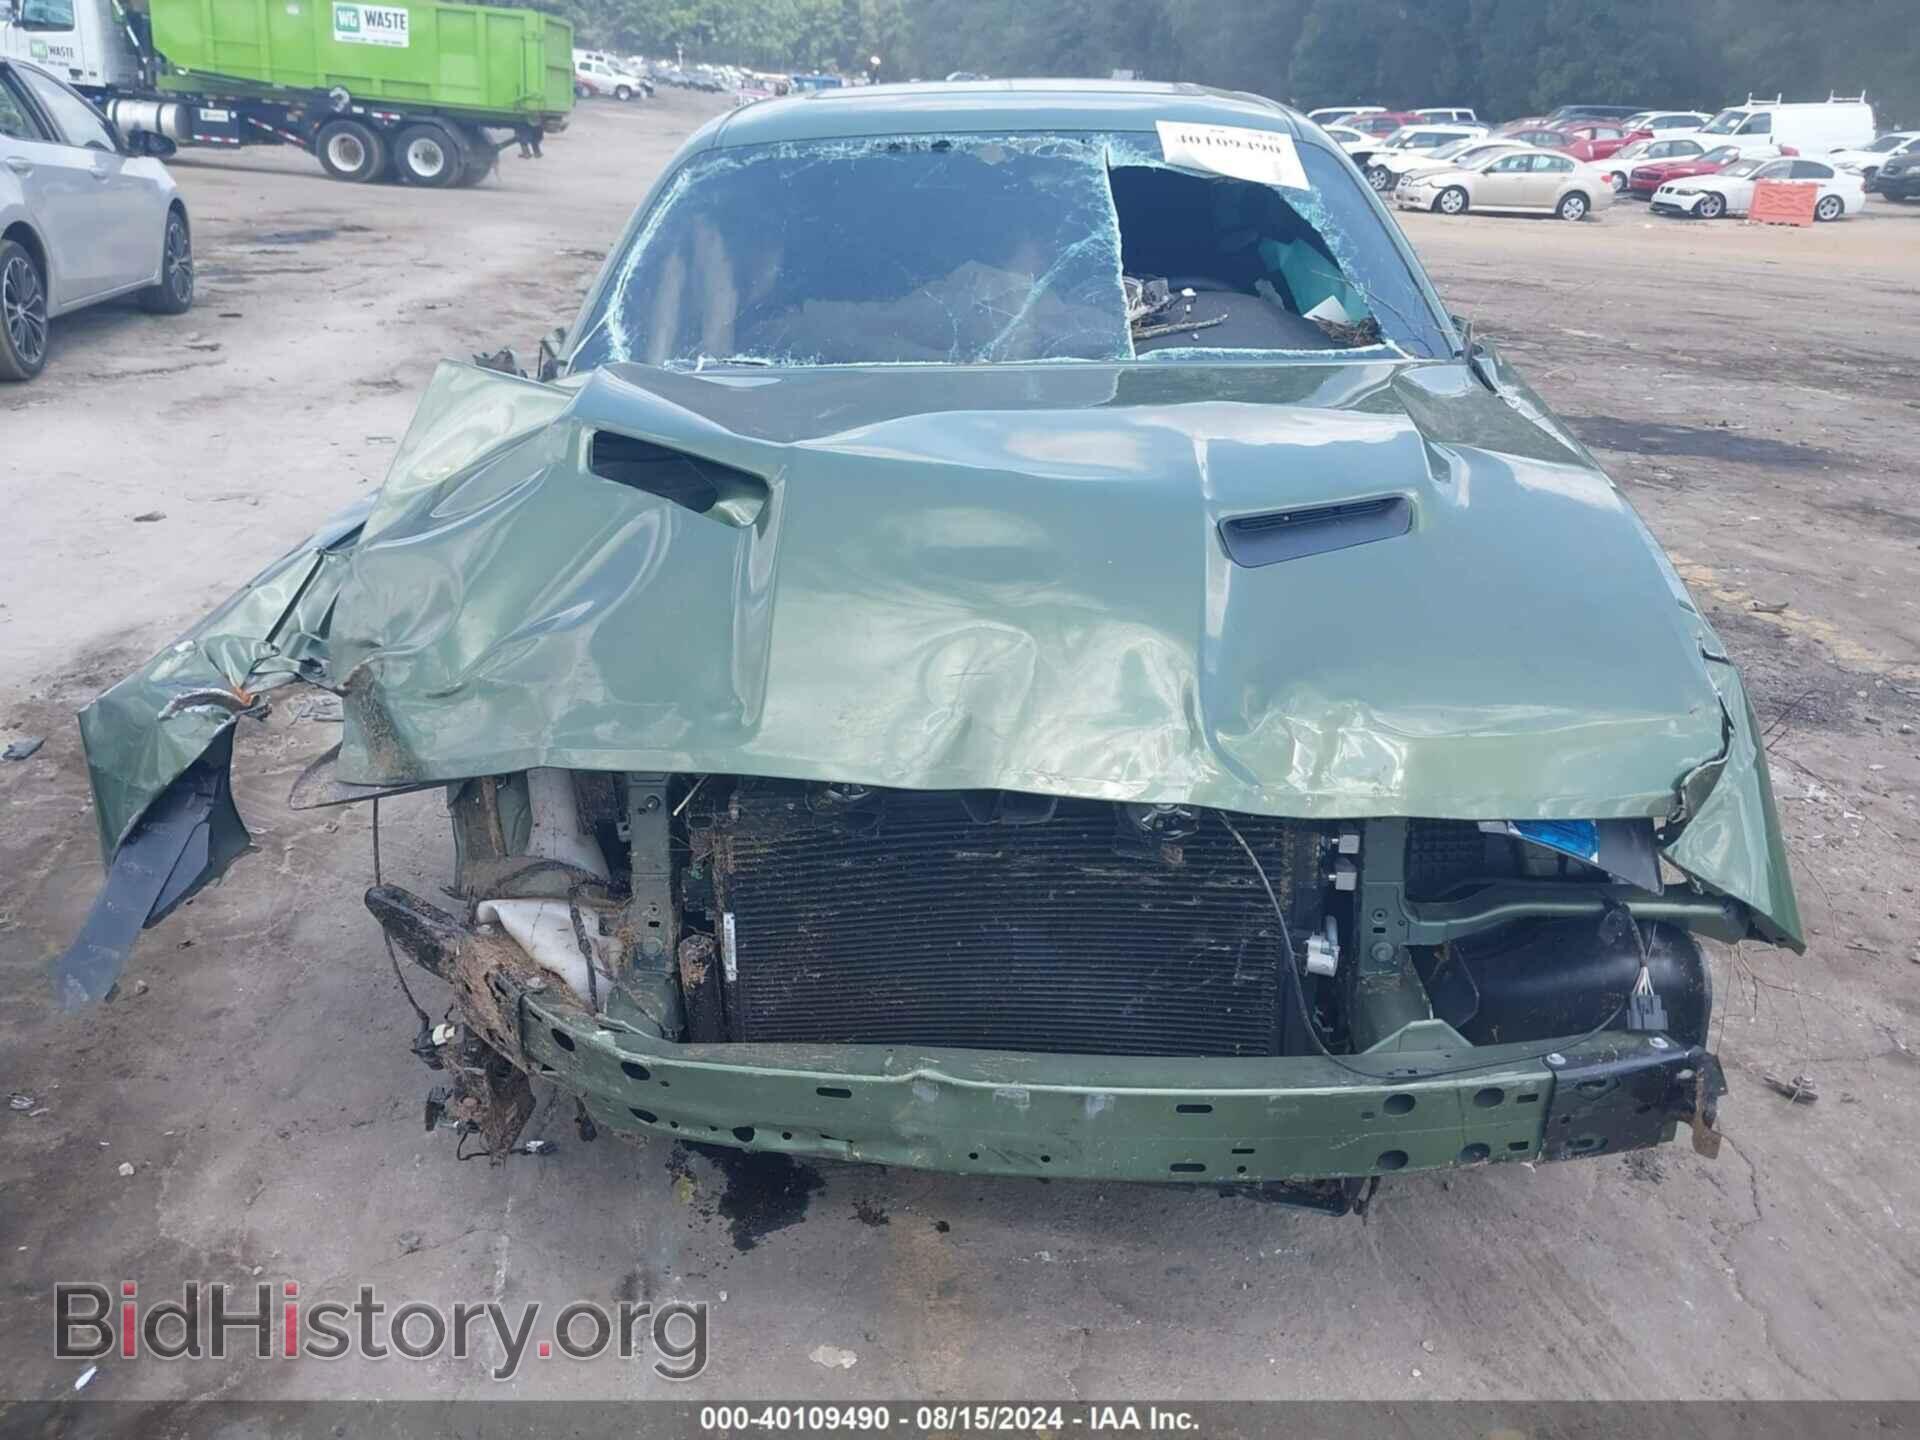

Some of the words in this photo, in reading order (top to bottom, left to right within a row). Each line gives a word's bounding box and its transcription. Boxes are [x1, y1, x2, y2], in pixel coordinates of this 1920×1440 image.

[337, 9, 358, 28] WG
[364, 9, 407, 31] WASTE
[49, 46, 74, 57] WASTE
